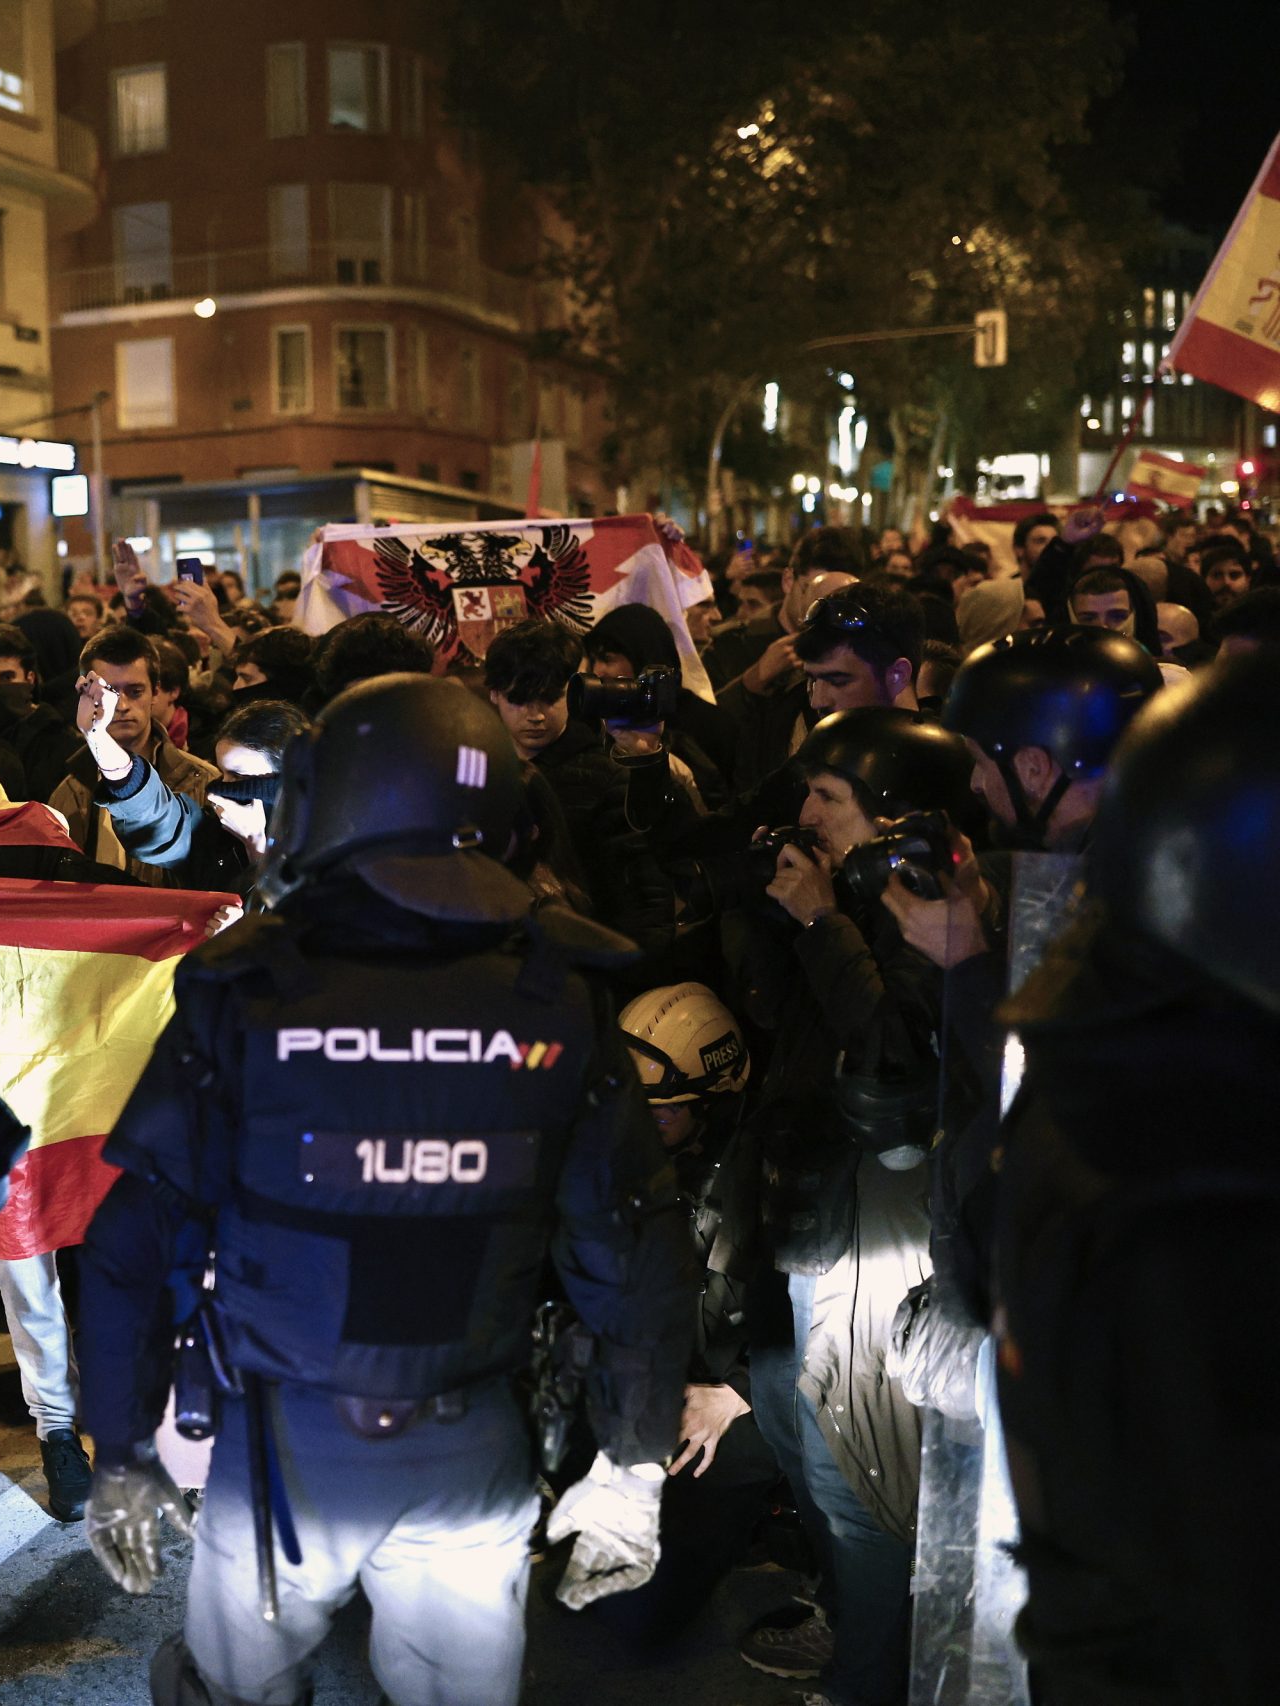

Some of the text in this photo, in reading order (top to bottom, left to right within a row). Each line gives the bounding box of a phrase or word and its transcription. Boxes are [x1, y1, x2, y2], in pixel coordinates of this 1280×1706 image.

[277, 1028, 522, 1063] POLICIA
[703, 1040, 739, 1072] PRESS
[356, 1139, 488, 1183] 1U80
